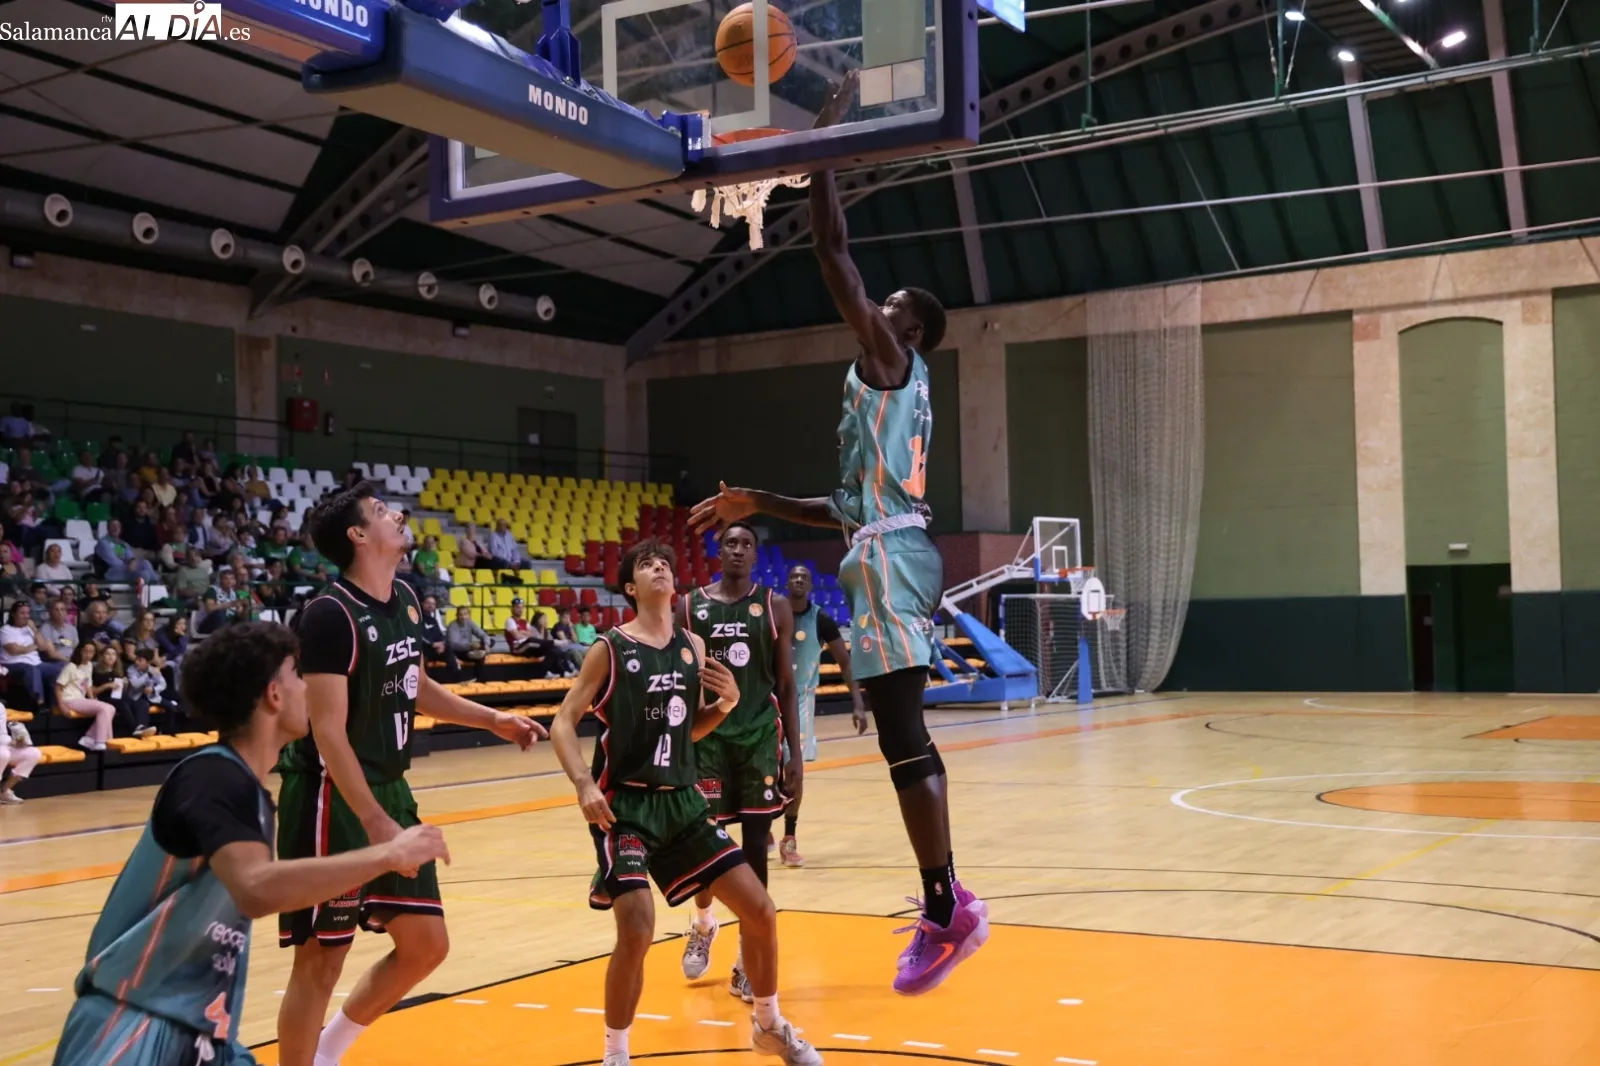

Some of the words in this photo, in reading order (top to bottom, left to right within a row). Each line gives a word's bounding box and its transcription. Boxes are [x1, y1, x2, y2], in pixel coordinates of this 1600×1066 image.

[294, 0, 369, 28] ONDO
[528, 84, 589, 126] MONDO
[653, 733, 672, 767] 12
